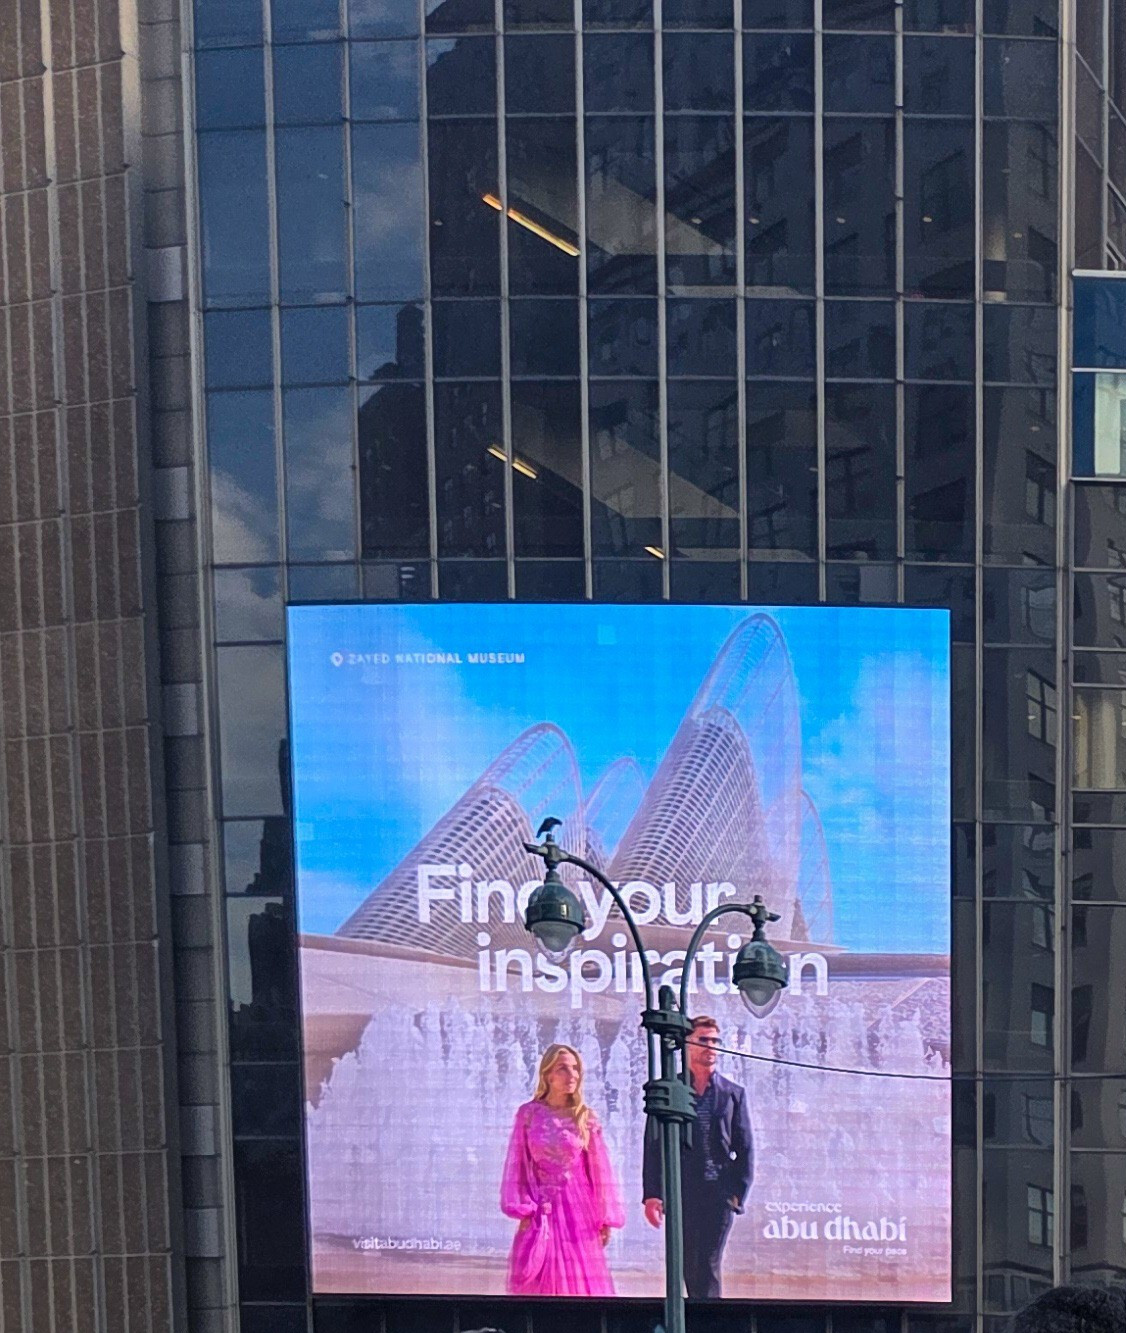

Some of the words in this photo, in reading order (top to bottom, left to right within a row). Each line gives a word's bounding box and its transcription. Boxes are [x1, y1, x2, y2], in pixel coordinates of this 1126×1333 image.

[395, 653, 463, 664] NATIONAL
[468, 653, 525, 664] MUSEUM
[577, 880, 737, 941] your
[477, 932, 828, 1009] inspiratin
[764, 1200, 842, 1214] experience
[763, 1215, 819, 1240] abu
